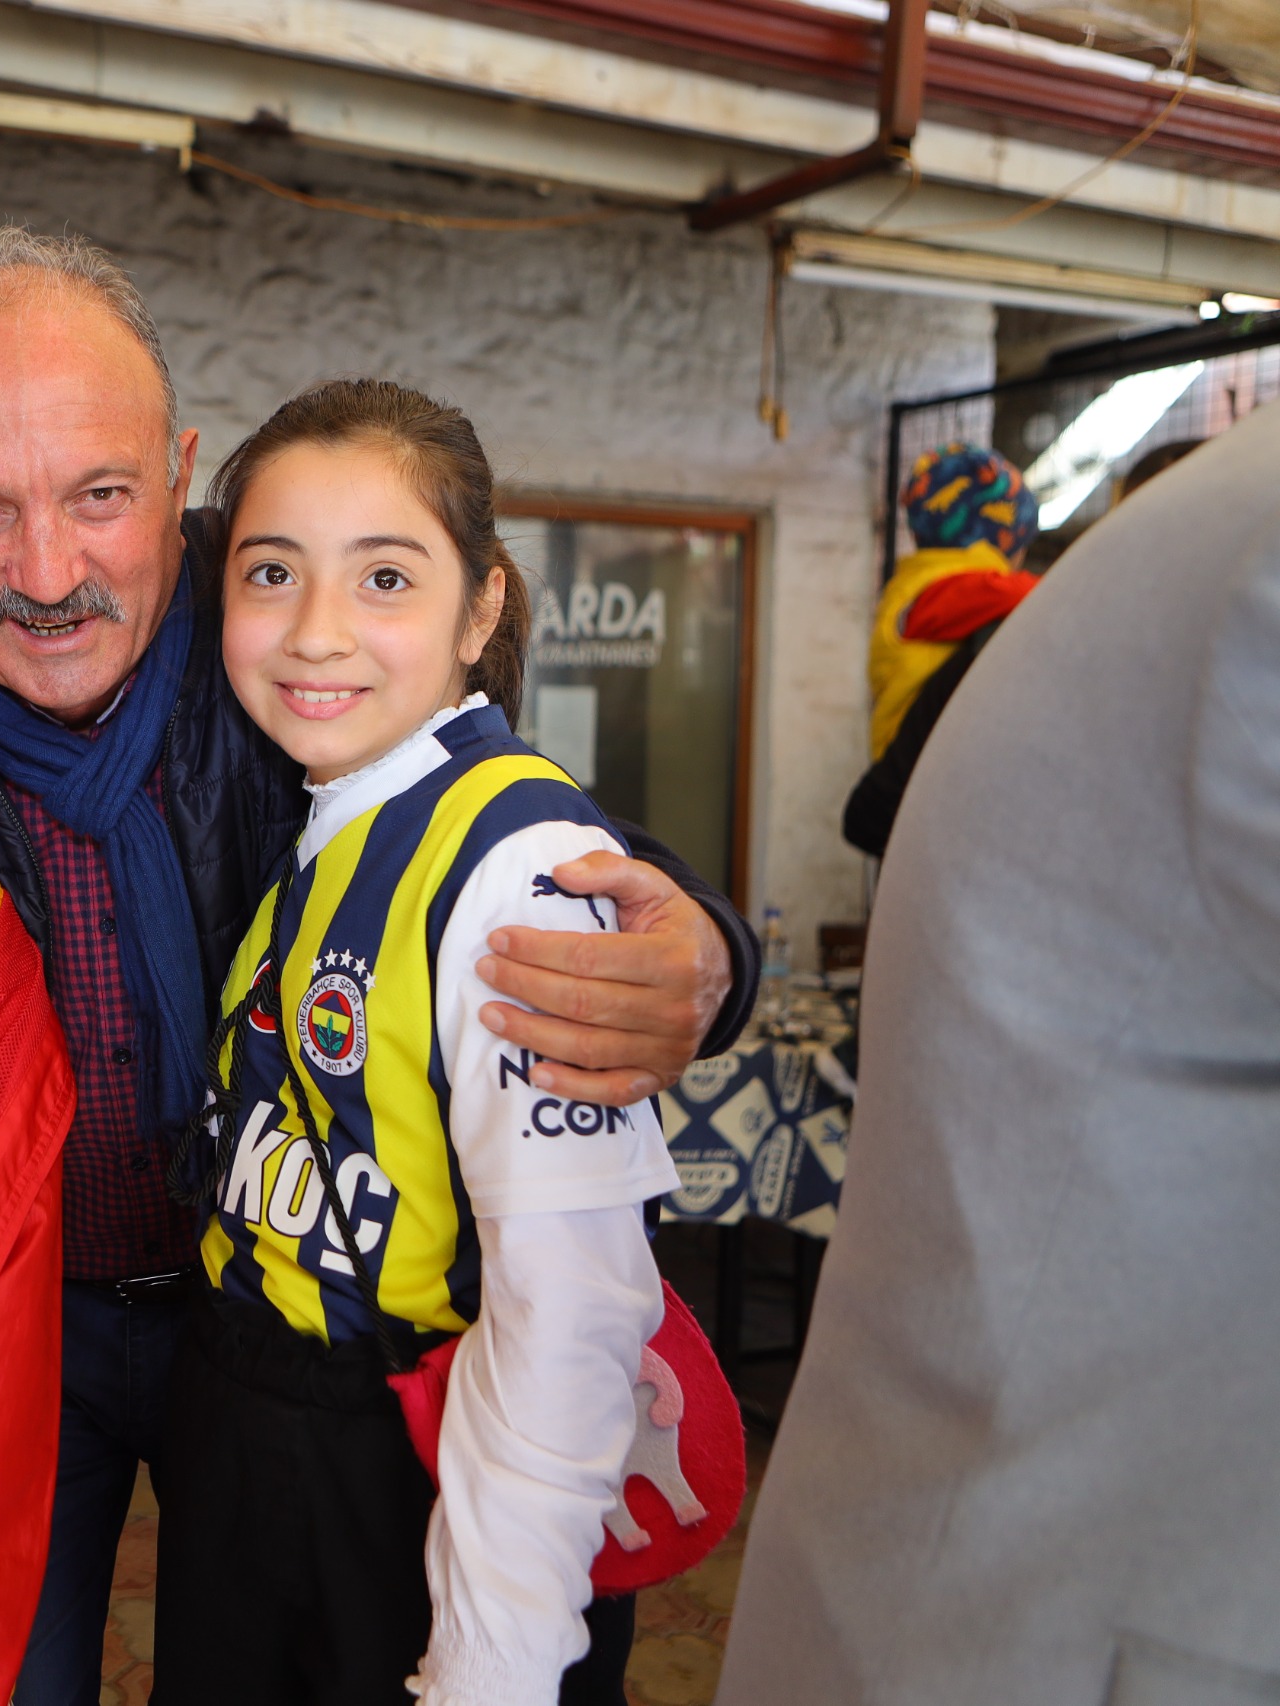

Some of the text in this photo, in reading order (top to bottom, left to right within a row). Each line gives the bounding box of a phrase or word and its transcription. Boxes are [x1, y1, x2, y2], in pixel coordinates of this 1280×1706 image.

[299, 976, 336, 1044] FENERBAHÇE
[339, 978, 359, 1006] SPOR
[321, 1058, 342, 1072] 1907
[219, 1100, 392, 1276] KOÇ
